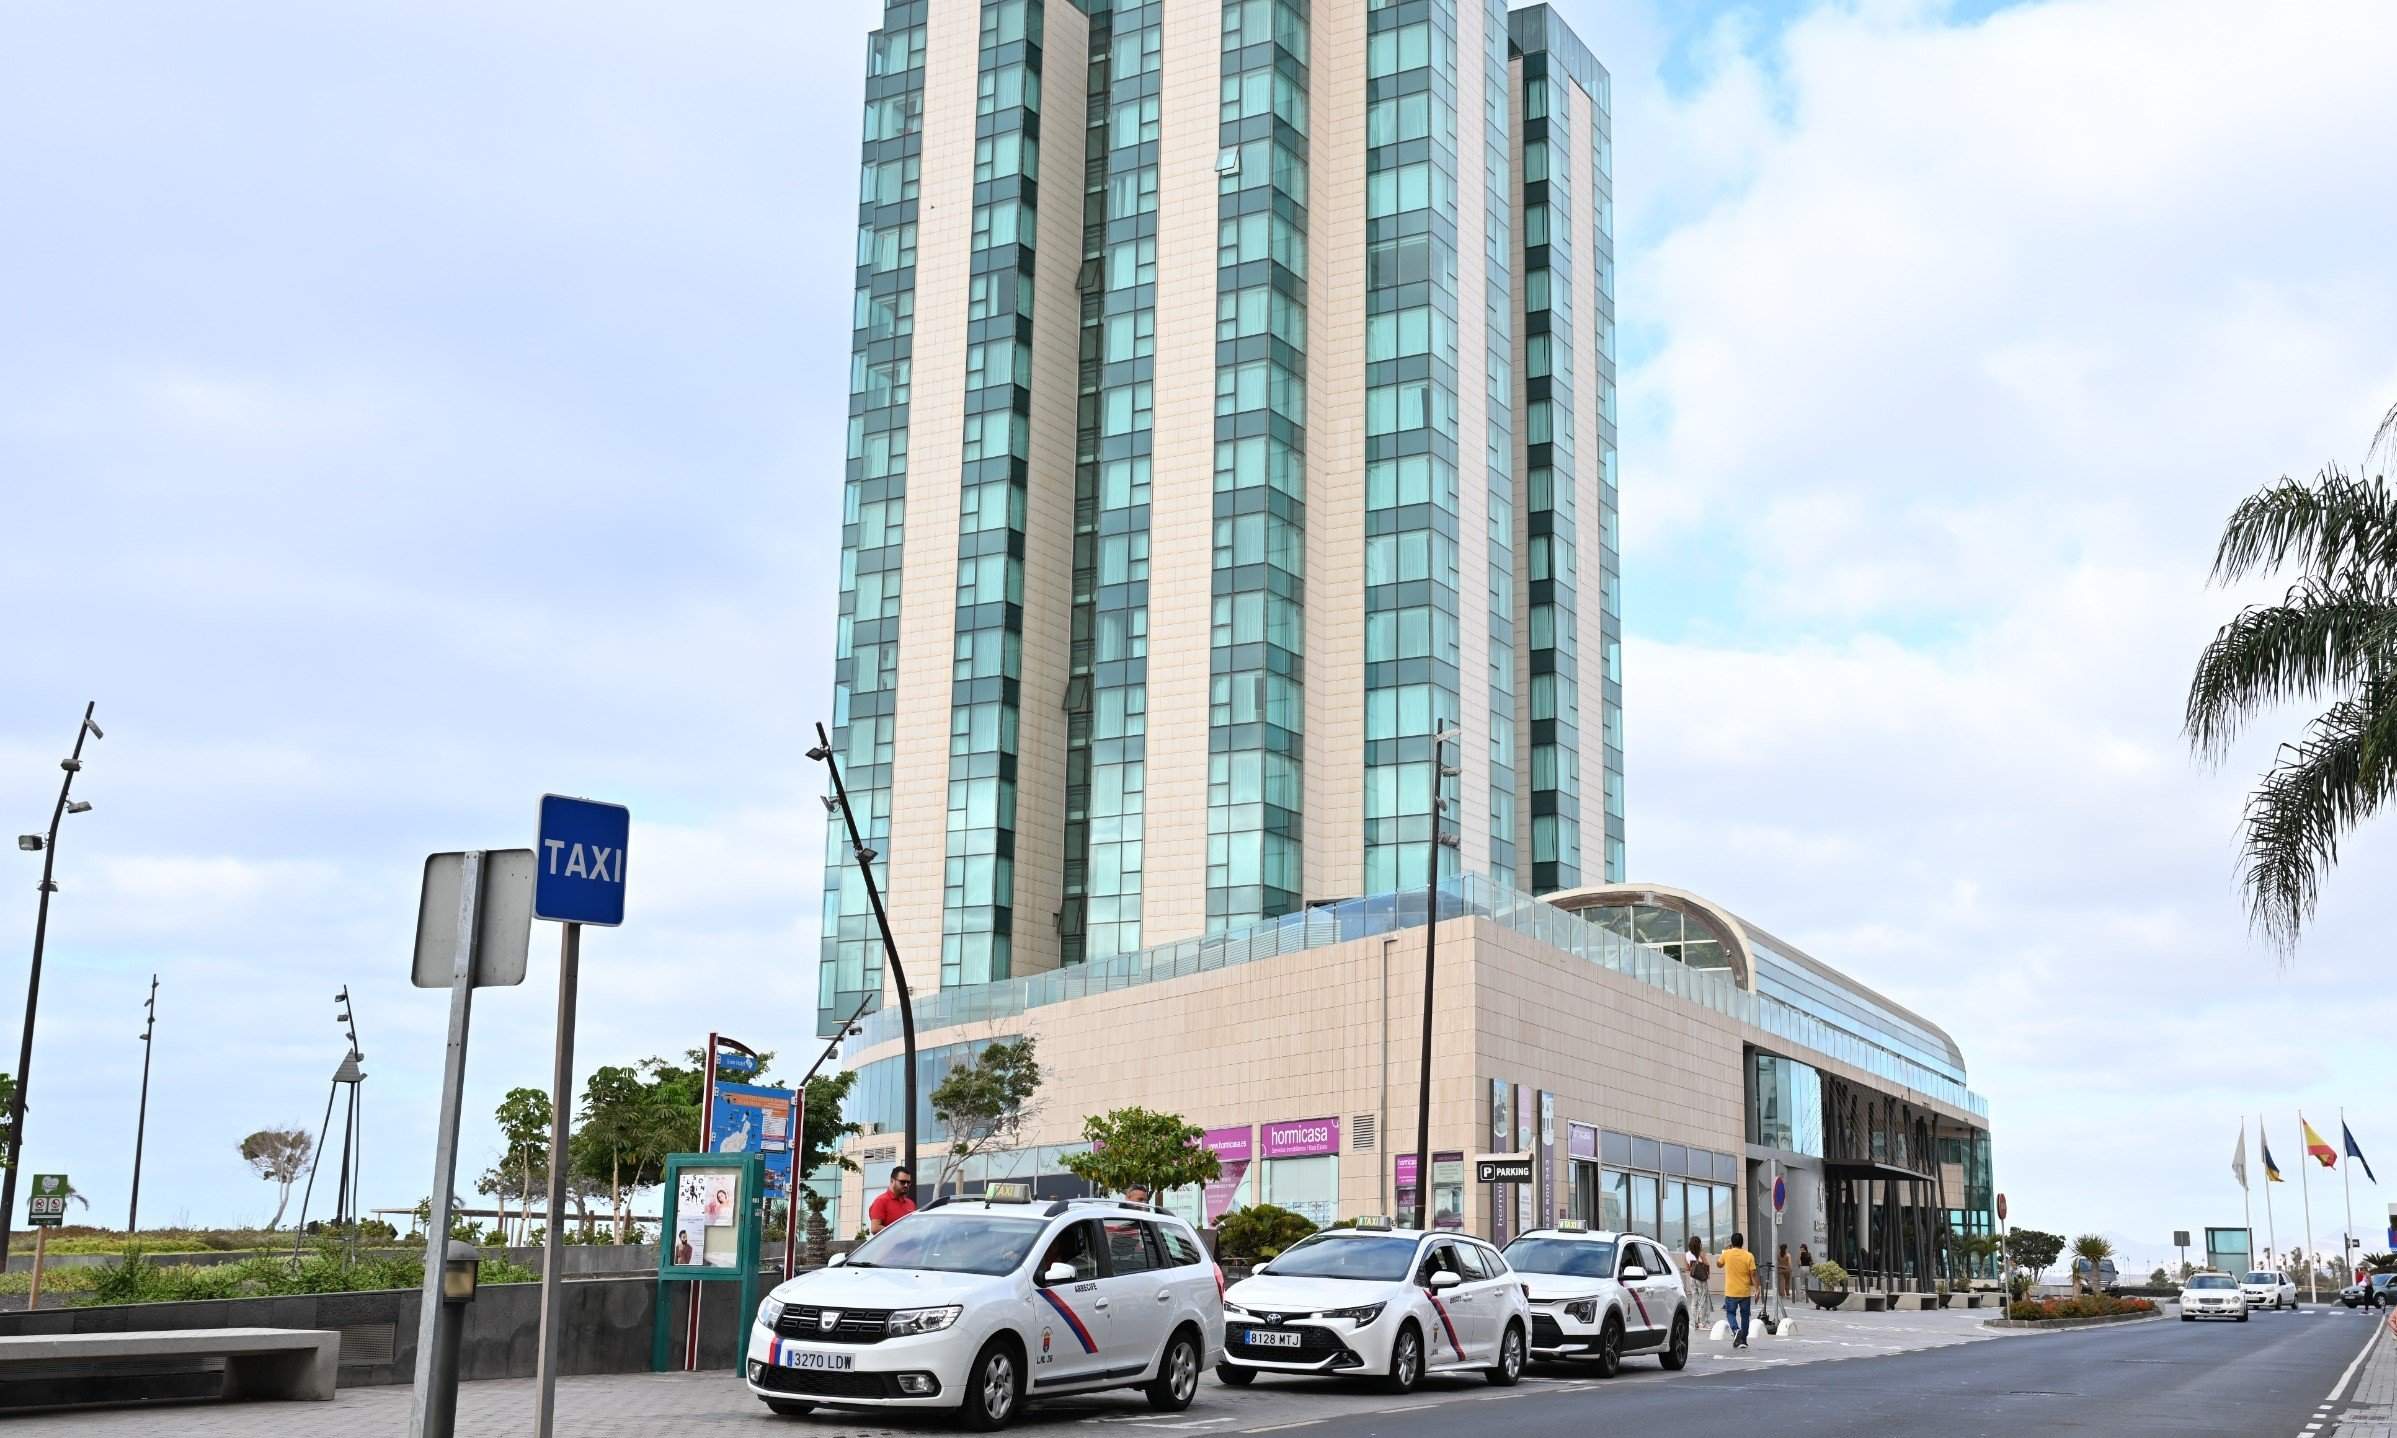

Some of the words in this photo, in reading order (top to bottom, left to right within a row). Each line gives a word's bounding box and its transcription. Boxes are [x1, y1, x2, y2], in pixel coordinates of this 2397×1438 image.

[544, 838, 622, 883] TAXI
[1271, 1124, 1328, 1145] hormicasa
[1483, 1166, 1492, 1178] P
[1496, 1167, 1529, 1177] PARKING
[1364, 1216, 1379, 1226] TAXI
[1564, 1220, 1577, 1229] TAXI
[1251, 1332, 1276, 1345] 8128
[1280, 1334, 1299, 1346] MTJ
[794, 1352, 824, 1368] 3270
[827, 1354, 852, 1369] LDW
